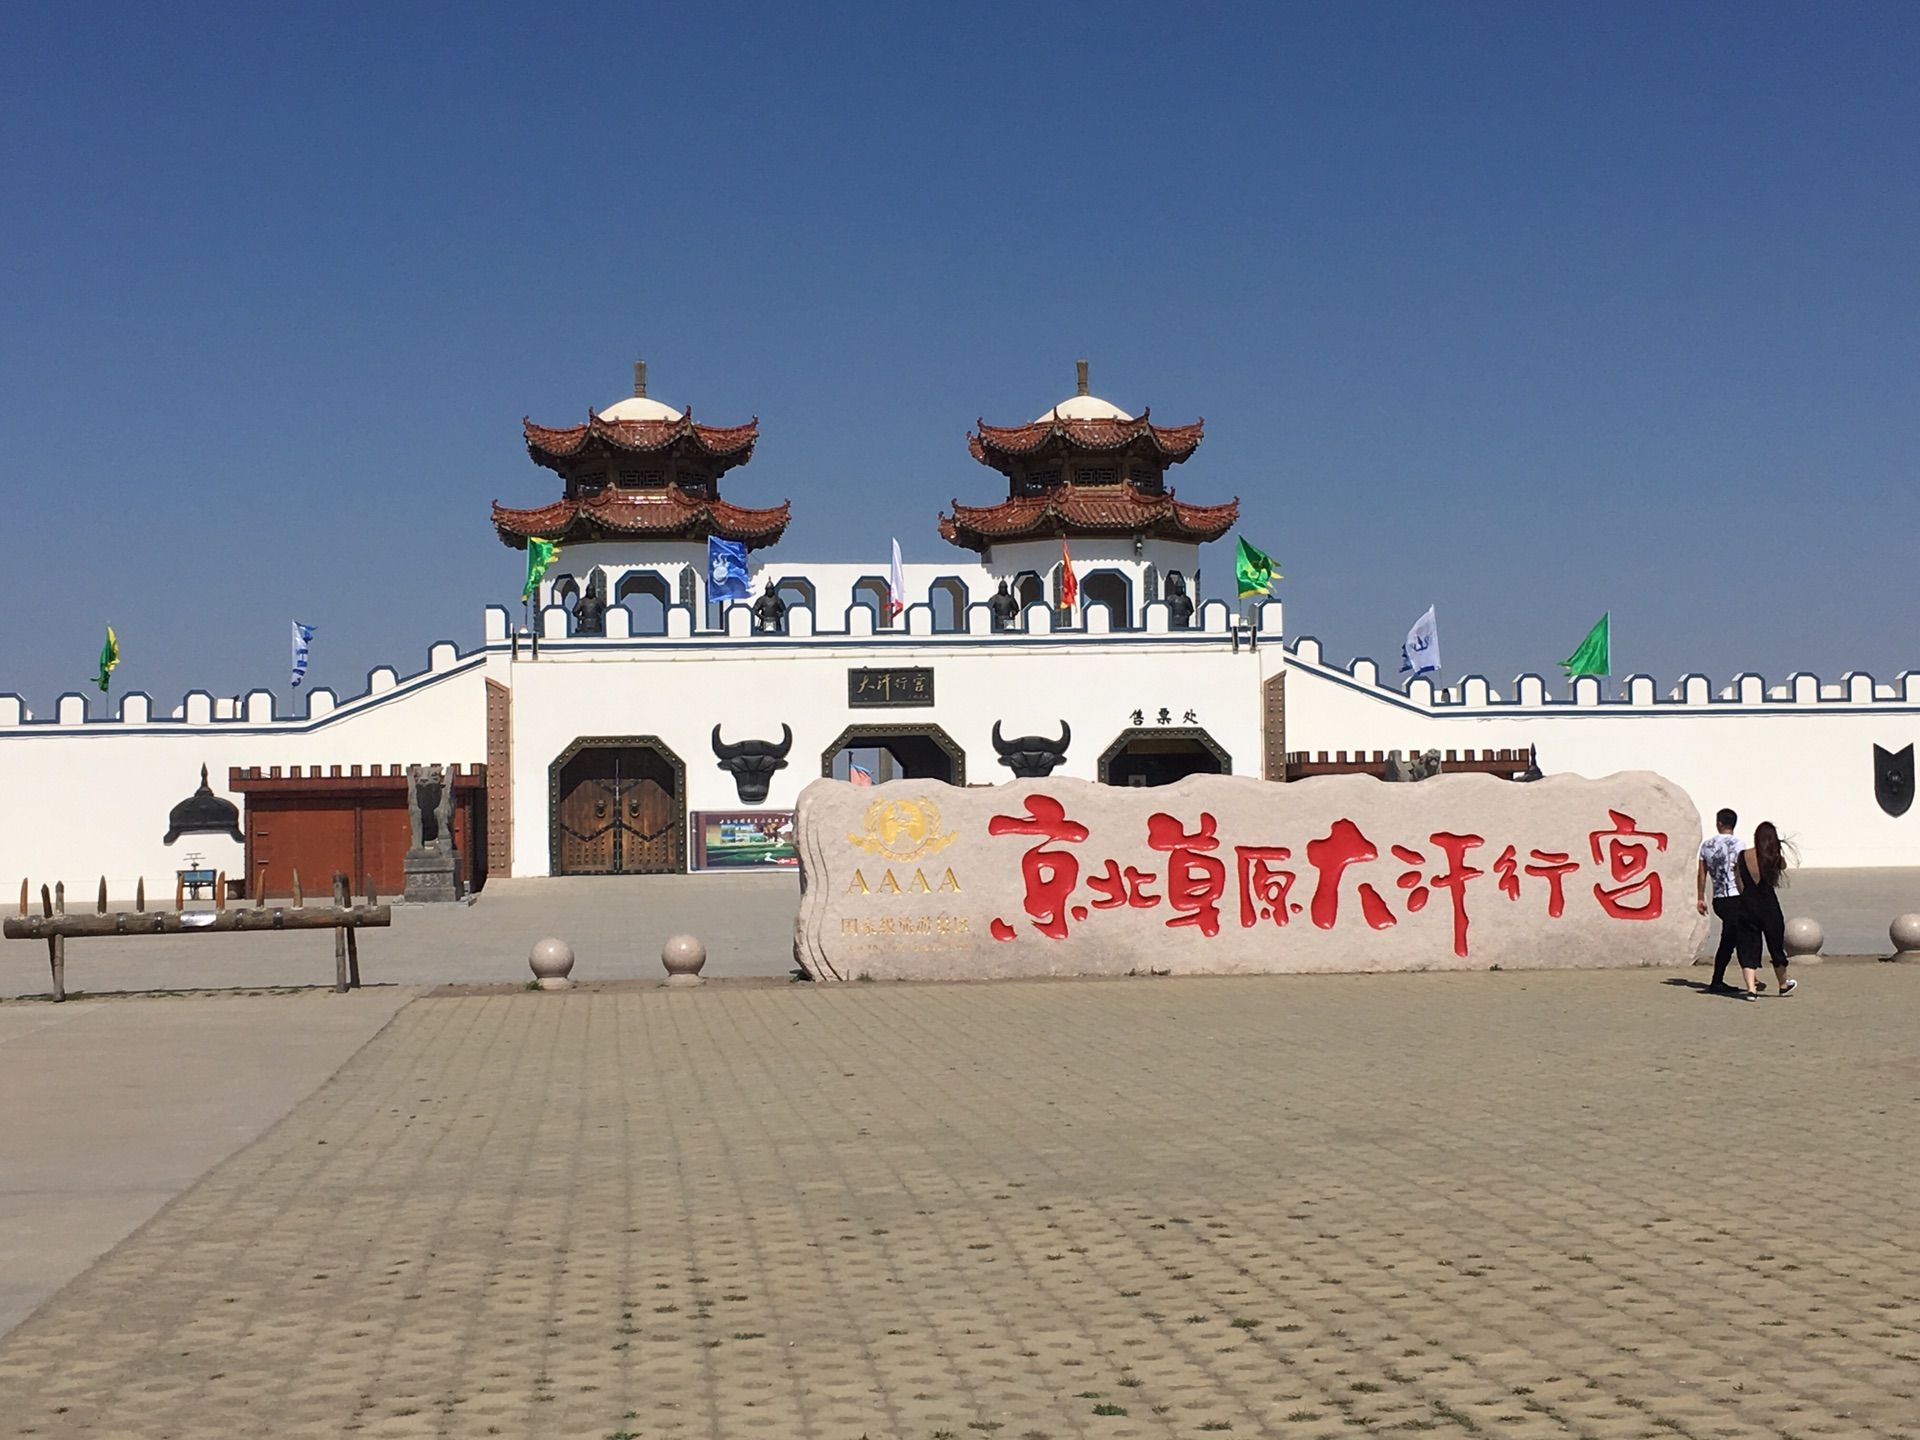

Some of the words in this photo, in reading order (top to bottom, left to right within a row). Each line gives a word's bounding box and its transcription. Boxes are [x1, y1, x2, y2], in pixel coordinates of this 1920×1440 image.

[1129, 708, 1199, 726] 售票处
[846, 867, 962, 895] AAAA
[988, 794, 1668, 955] 京北草原大汗行宫
